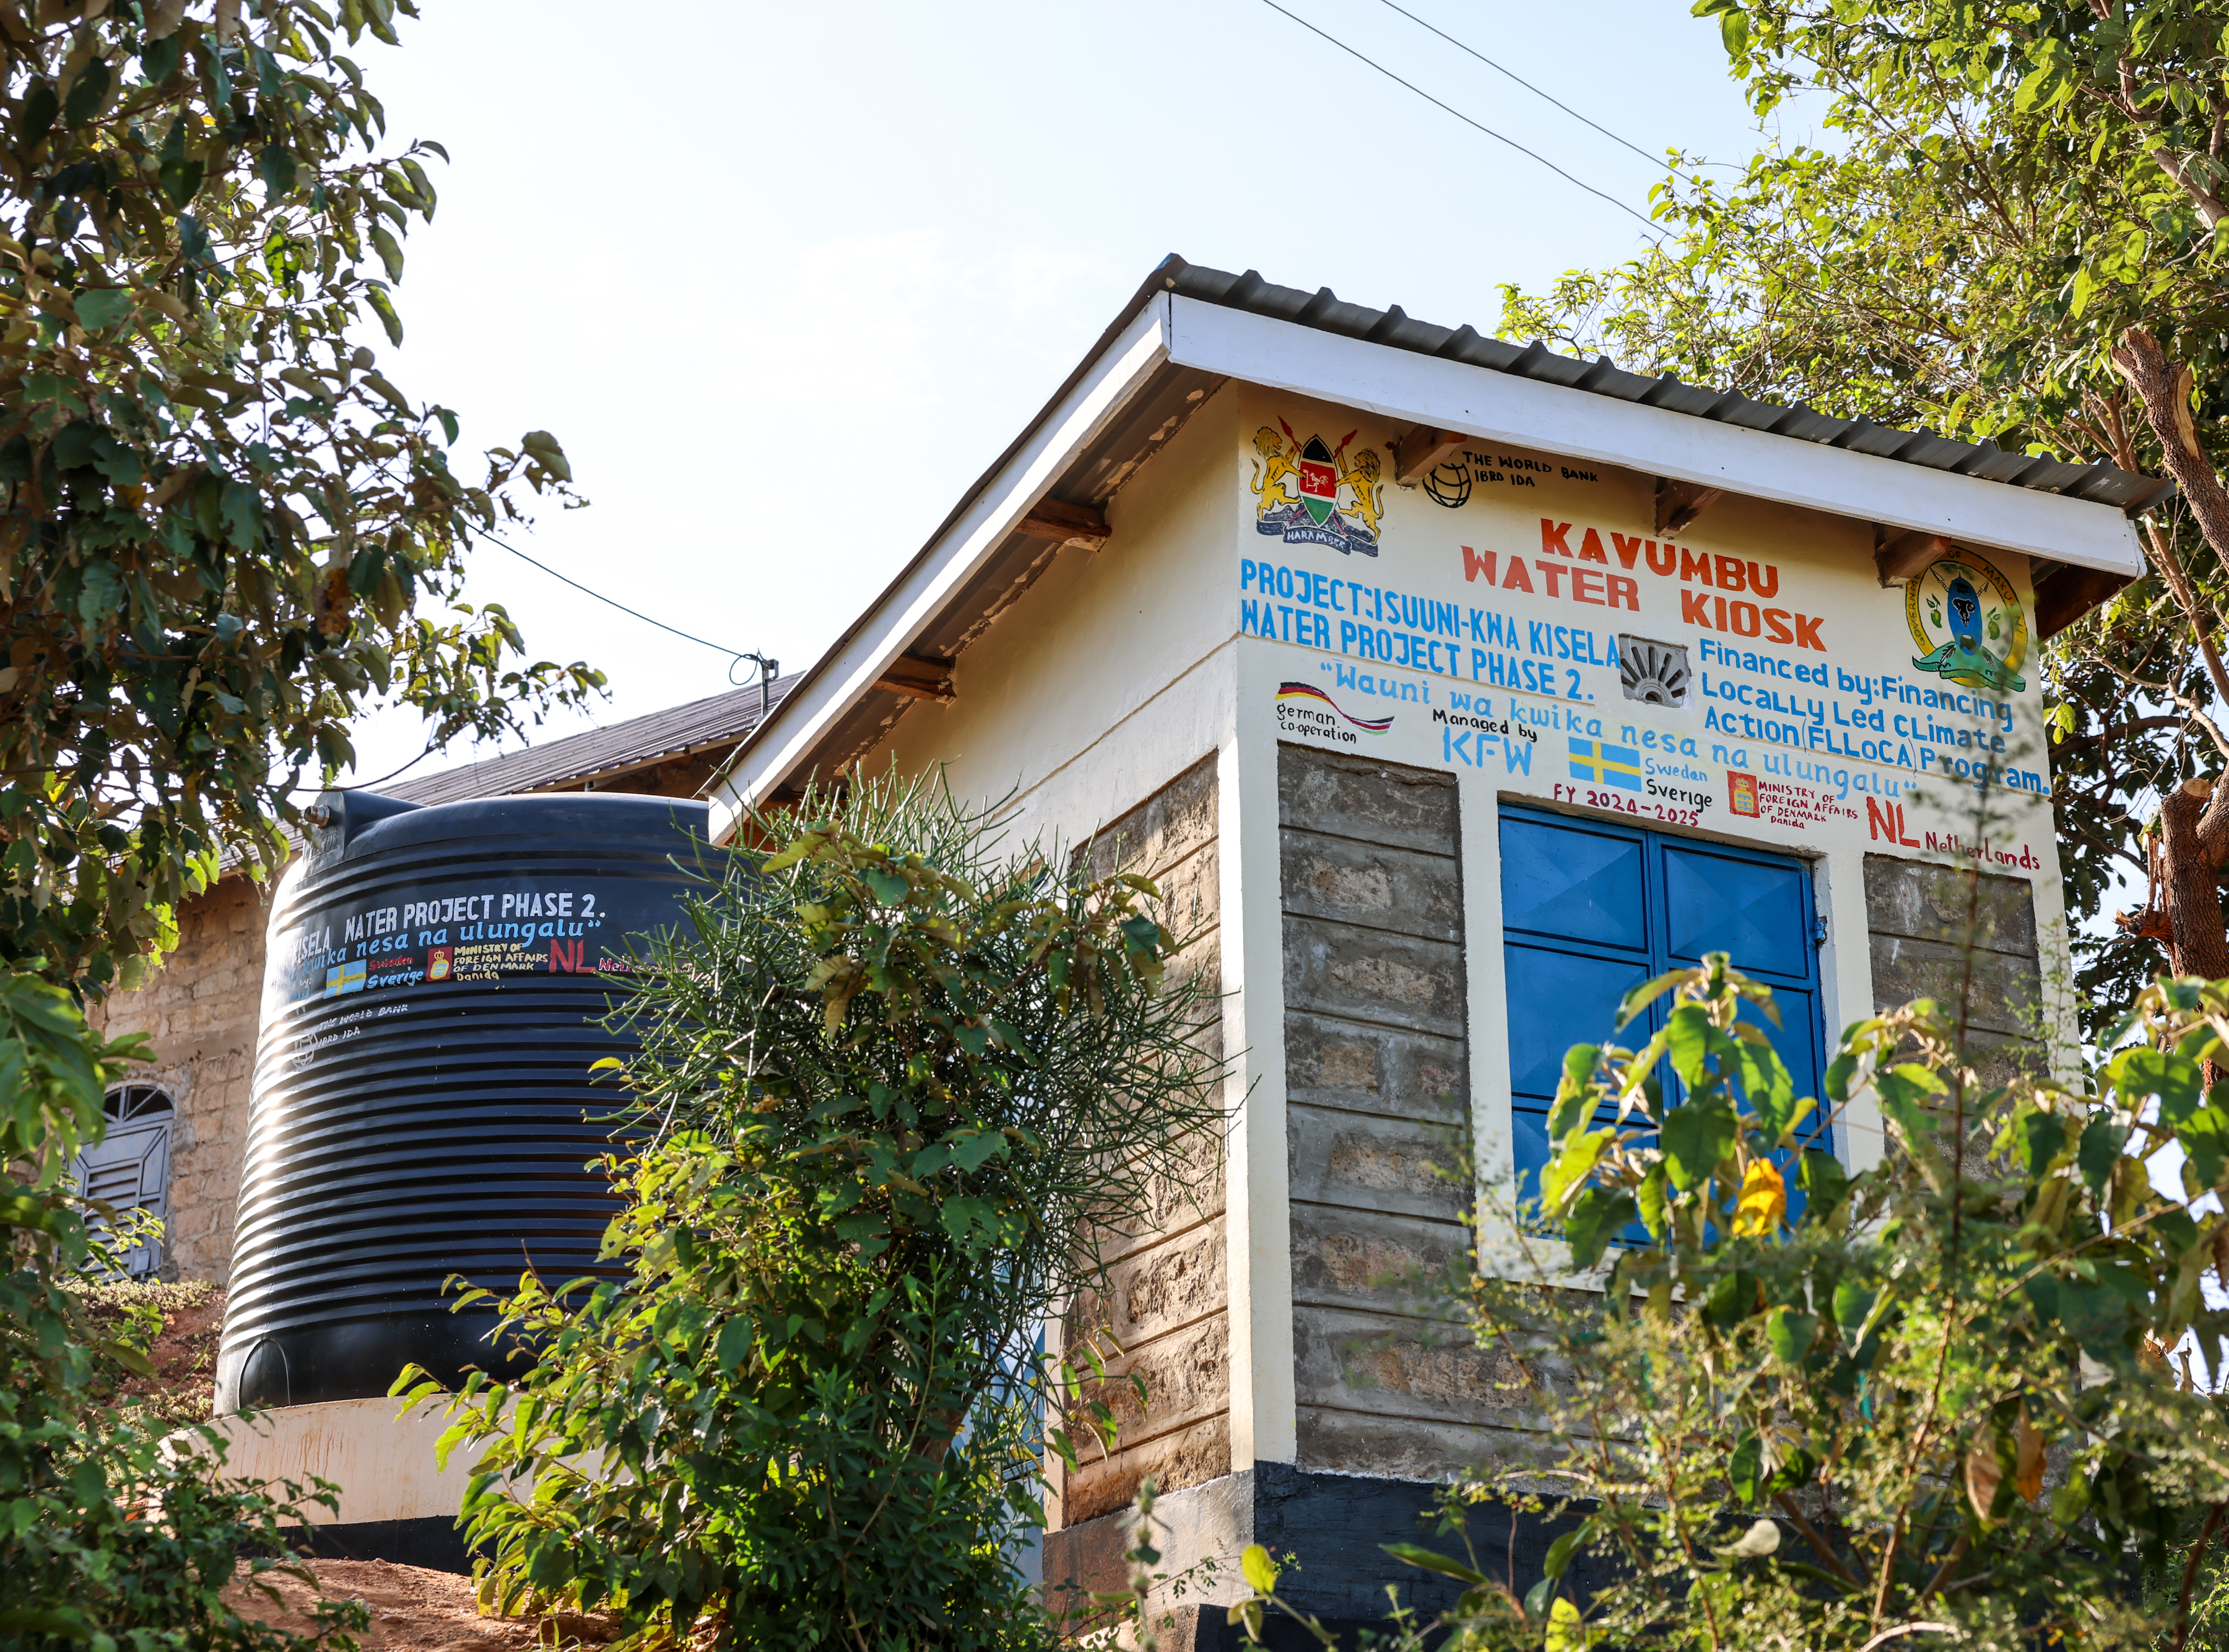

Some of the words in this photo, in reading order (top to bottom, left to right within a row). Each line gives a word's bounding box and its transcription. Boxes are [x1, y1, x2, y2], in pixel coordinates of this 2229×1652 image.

[1462, 451, 1492, 466] THE
[1498, 456, 1552, 472] WORLD
[1561, 466, 1599, 482] BANK
[1474, 469, 1504, 482] IBRD
[1510, 474, 1536, 487] IDA
[1287, 530, 1345, 549] HARAMBEE
[1540, 518, 1779, 598] KAVUMBU
[1948, 550, 1961, 559] OF
[1460, 545, 1640, 612] WATER
[1680, 588, 1828, 653] KIOSK
[1241, 599, 1331, 650] WATER
[1340, 619, 1461, 677] PROJECT
[1471, 648, 1556, 695] PHASE
[1565, 669, 1594, 701] 2.
[1528, 620, 1621, 669] KISELA
[1700, 638, 1829, 688] Financed
[1276, 703, 1336, 726] german
[1432, 708, 1510, 734] Managed
[1518, 725, 1537, 743] by
[1833, 701, 1885, 733] Led
[1280, 721, 1357, 744] co-operation
[1449, 690, 1493, 718] wa
[1510, 697, 1603, 738] kwika
[1620, 724, 1698, 759] nesa
[1711, 744, 1750, 769] na
[1443, 726, 1532, 776] KFW
[1645, 757, 1708, 783] Sweden
[1553, 783, 1576, 804] FY
[1586, 790, 1698, 827] 2024-2025
[1646, 778, 1713, 813] Sverige
[1758, 781, 1815, 799] MINISTRY
[1822, 794, 1835, 804] OF
[1759, 793, 1809, 809] FOREIGN
[1814, 802, 1859, 819] AFFAIRS
[1760, 805, 1773, 814] OF
[1778, 807, 1827, 822] DENMARK
[1770, 815, 1805, 829] Danida
[1866, 796, 1921, 849] NL
[344, 906, 398, 944] WATER
[403, 894, 494, 929] PROJECT
[501, 892, 573, 918] PHASE
[581, 893, 606, 918] 2.
[355, 933, 409, 958] nesa
[418, 928, 448, 947] na
[454, 943, 508, 956] MINISTRY
[510, 942, 523, 953] OF
[549, 939, 597, 973] NL
[368, 955, 414, 971] Sweden
[453, 953, 502, 967] FOREIGN
[505, 952, 549, 964] AFFAIRS
[453, 964, 469, 973] OF
[366, 967, 424, 989] Sverige
[456, 970, 500, 981] Danida
[318, 1017, 337, 1032] THE
[339, 1009, 373, 1025] WORLD
[378, 1004, 409, 1017] BANK
[318, 1034, 339, 1048] IBRD
[342, 1026, 361, 1040] IDA
